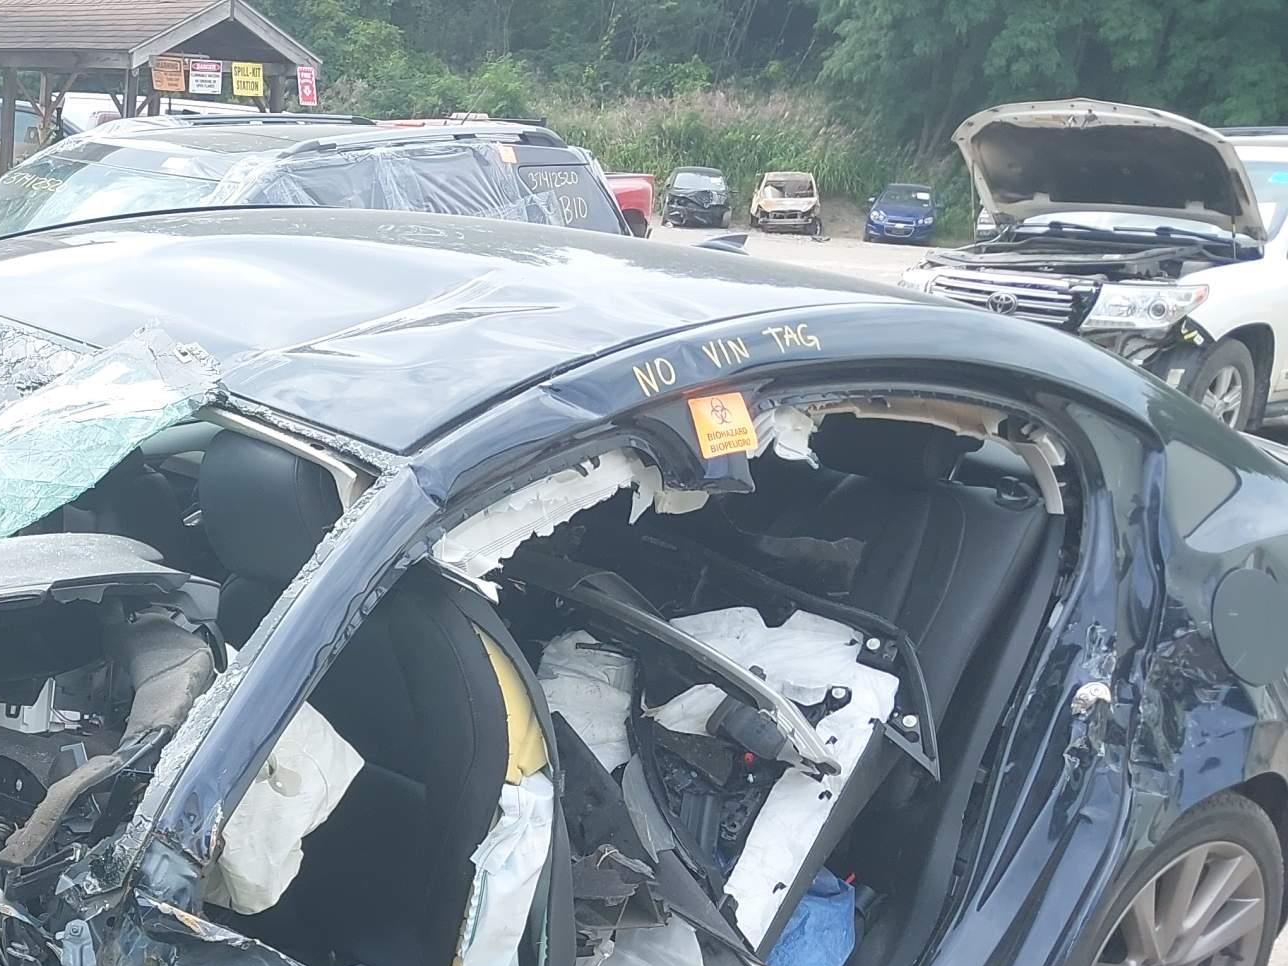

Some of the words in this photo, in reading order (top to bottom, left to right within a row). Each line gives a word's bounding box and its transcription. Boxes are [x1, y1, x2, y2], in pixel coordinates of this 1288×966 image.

[234, 66, 261, 78] SPILL-KIT
[236, 80, 259, 92] STATION
[528, 171, 578, 191] 37412520
[632, 357, 676, 397] NO
[702, 336, 751, 369] VIN
[762, 323, 822, 354] TAG
[707, 427, 748, 442] BIOHAZARD
